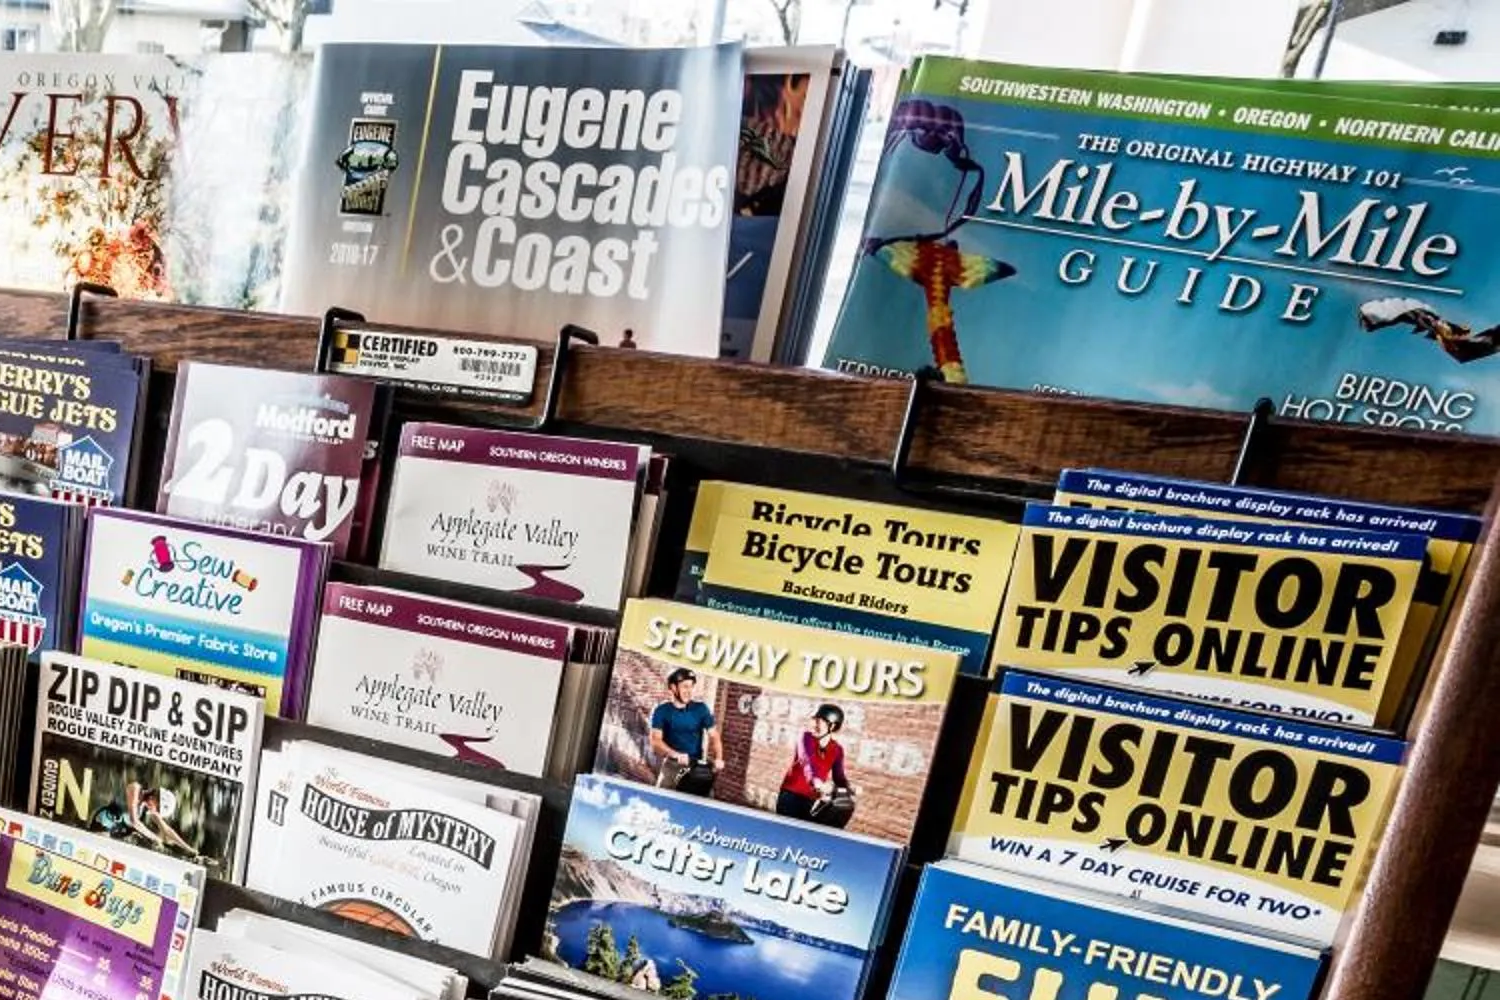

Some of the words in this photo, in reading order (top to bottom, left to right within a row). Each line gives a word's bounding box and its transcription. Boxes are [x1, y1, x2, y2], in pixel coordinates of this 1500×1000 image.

[18, 71, 117, 89] OREGON
[353, 124, 393, 142] EUGENE
[452, 69, 683, 162] Eugene
[959, 75, 1093, 107] SOUTHWESTERN
[1096, 91, 1212, 119] WASHINGTON
[1233, 107, 1313, 131] OREGON
[1334, 116, 1445, 145] NORTHERN
[441, 143, 728, 231] Cascades
[1077, 133, 1121, 155] THE
[1124, 138, 1234, 170] ORIGINAL
[1240, 152, 1357, 186] HIGHWAY
[1360, 168, 1402, 189] 101
[987, 151, 1459, 277] Mile-by-Mile
[1058, 249, 1321, 322] GUIDE
[362, 335, 439, 357] CERTIFIED
[49, 398, 117, 432] JETS
[256, 403, 357, 439] Medford
[1280, 394, 1353, 422] HOT
[1335, 373, 1475, 420] BIRDING
[170, 418, 235, 504] 2
[232, 446, 360, 541] Day
[411, 434, 436, 450] FREE
[438, 439, 465, 453] MAP
[489, 446, 538, 462] SOUTHERN
[540, 452, 582, 466] OREGON
[583, 456, 628, 471] WINERIES
[175, 541, 234, 580] Sew
[426, 543, 467, 561] WINE
[471, 550, 516, 567] TRAIL
[430, 508, 518, 550] Applegate
[524, 519, 579, 560] Valley
[1048, 511, 1072, 526] The
[1074, 513, 1124, 533] digital
[1126, 518, 1193, 540] brochure
[1196, 524, 1253, 546] display
[1257, 529, 1292, 545] rack
[1297, 532, 1327, 548] has
[1331, 536, 1400, 554] arrived!
[741, 530, 864, 576] Bicycle
[876, 552, 973, 594] Tours
[1031, 533, 1397, 642] VISITOR
[135, 567, 244, 615] Creative
[782, 580, 858, 606] Backroad
[858, 594, 909, 615] Riders
[90, 611, 142, 635] Oregon's
[144, 624, 195, 645] Premier
[198, 632, 240, 655] Fabric
[243, 642, 278, 662] Store
[643, 615, 789, 681] SEGWAY
[798, 650, 927, 698] TOURS
[1015, 605, 1133, 660] TIPS
[1153, 622, 1383, 692] ONLINE
[47, 664, 100, 709] ZIP
[108, 676, 161, 724] DIP
[168, 691, 184, 728] &
[193, 698, 248, 744] SIP
[351, 703, 389, 725] WINE
[395, 715, 438, 735] TRAIL
[355, 674, 442, 714] Applegate
[449, 690, 504, 733] Valley
[48, 702, 83, 721] ROGUE
[85, 711, 124, 732] VALLEY
[127, 721, 168, 743] ZIPLINE
[171, 732, 243, 763] ADVENTURES
[48, 717, 97, 740] ROGUE
[101, 731, 163, 757] RAFTING
[168, 748, 242, 776] COMPANY
[1007, 702, 1372, 840] VISITOR
[303, 786, 370, 838] HOUSE
[372, 812, 394, 840] of
[396, 810, 493, 864] MYSTERY
[691, 824, 779, 860] Adventures
[782, 845, 830, 872] Near
[988, 772, 1106, 835] TIPS
[1125, 802, 1355, 889] ONLINE
[604, 825, 736, 885] Crater
[742, 858, 849, 915] Lake
[989, 836, 1035, 858] WIN
[1036, 848, 1052, 863] A
[1059, 850, 1078, 868] 7
[1080, 856, 1124, 879] DAY
[1128, 868, 1203, 896] CRUISE
[1205, 883, 1253, 907] FOR
[311, 882, 366, 902] FAMOUS
[371, 886, 433, 934] CIRCULAR
